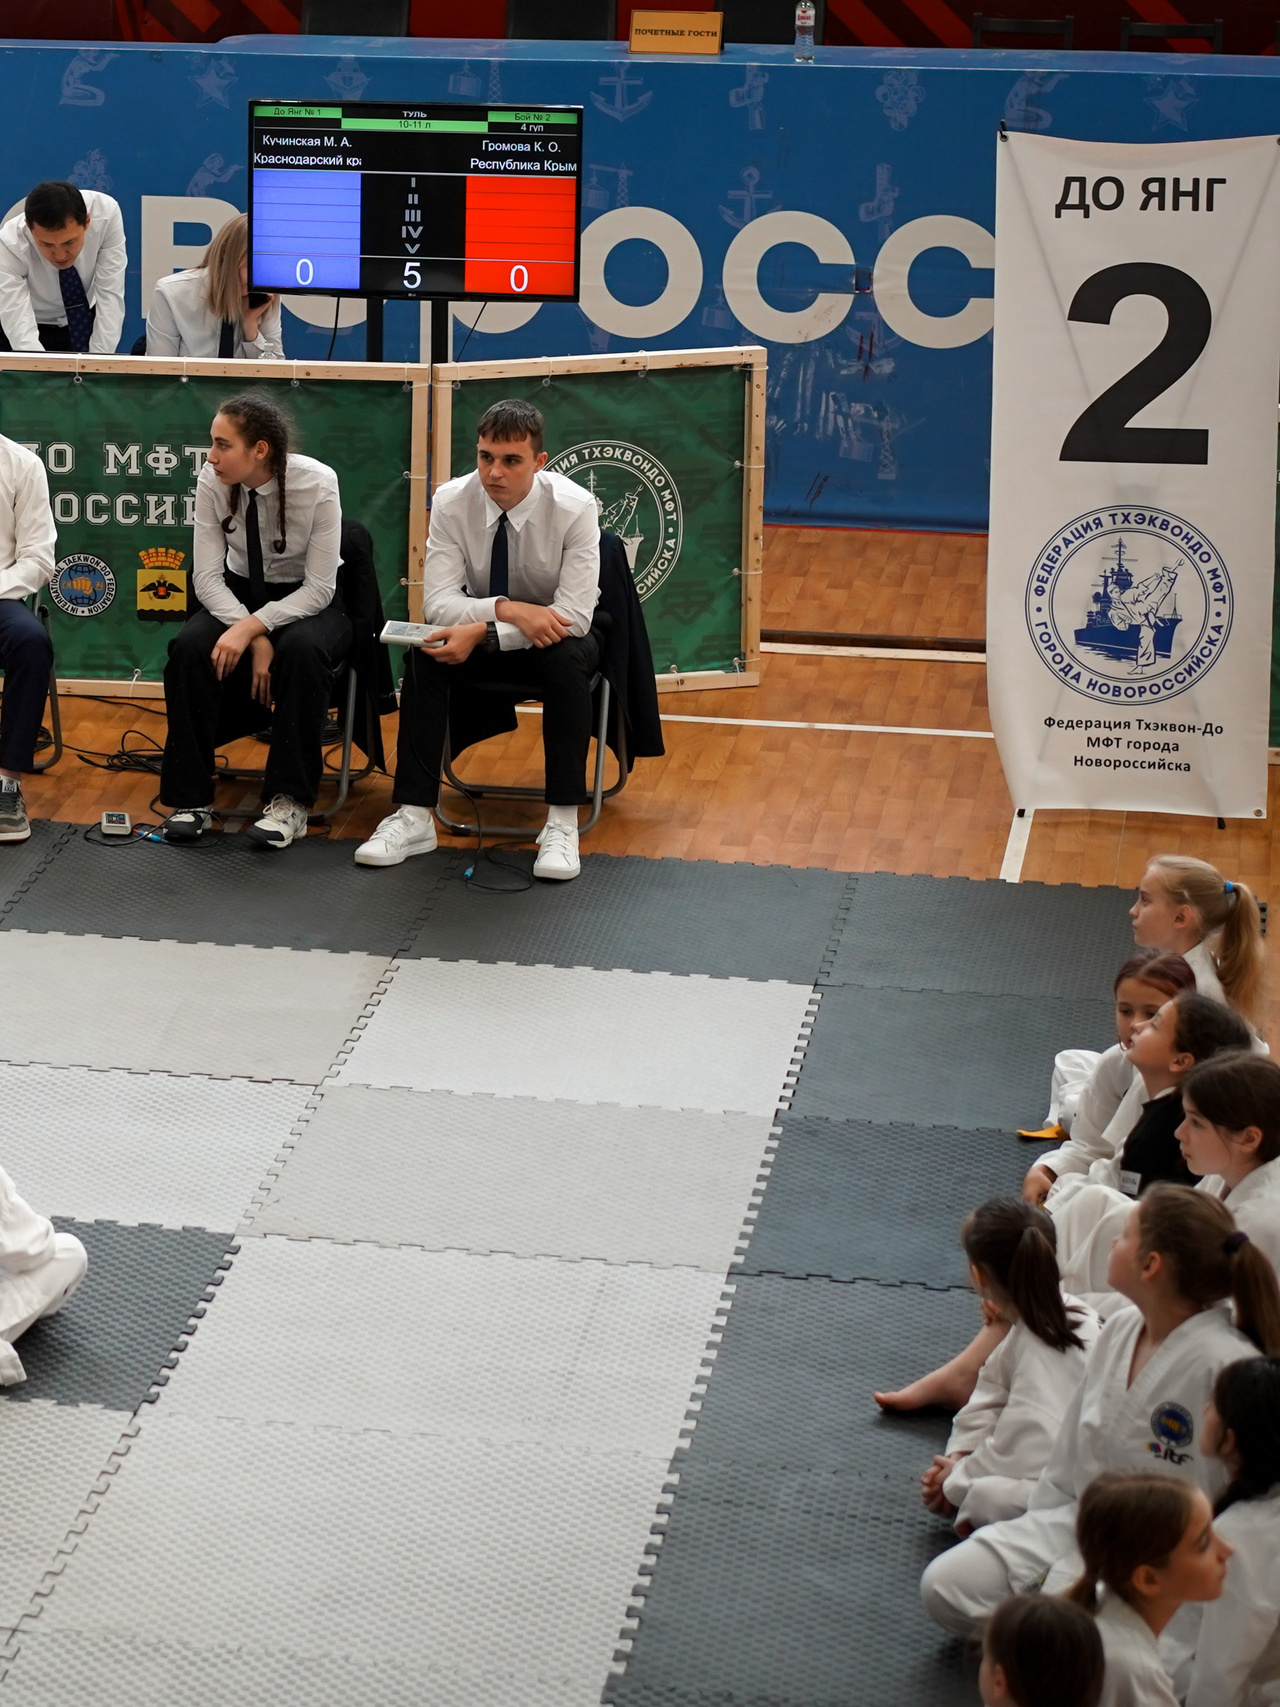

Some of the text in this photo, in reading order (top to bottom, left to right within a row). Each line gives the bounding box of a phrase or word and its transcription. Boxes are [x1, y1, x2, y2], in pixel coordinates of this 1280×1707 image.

[634, 28, 685, 37] ПОЧЕТНЫЕ
[273, 107, 285, 116] До
[287, 108, 303, 116] Янг
[514, 113, 531, 121] Бой
[399, 120, 422, 129] 10-11
[520, 123, 544, 133] 4 гуп
[262, 135, 353, 147] Кучинская М. А.
[482, 140, 562, 152] Громова К. О.
[253, 152, 343, 166] Краснодарский
[470, 158, 577, 172] Республика Крым
[1054, 175, 1227, 219] ДО ЯНГ
[405, 209, 421, 222] III
[401, 226, 424, 239] IV
[405, 243, 421, 254] V
[295, 258, 314, 286] 0
[403, 262, 422, 289] 5
[509, 264, 529, 292] 0
[1058, 261, 1212, 465] 2
[104, 443, 212, 477] МФТ
[582, 446, 666, 488] ТХЭКВОНДО
[660, 488, 677, 522] МФТ
[1034, 512, 1226, 605] ФЕДЕРАЦИЯ ТХЭКВОНДО МФТ
[51, 566, 79, 615] INTERNATIONAL
[87, 578, 115, 615] FEDERATION
[1034, 620, 1224, 699] ГОРОДА НОВОРОССИЙСКА
[1044, 716, 1224, 736] Федерация Тхэквон-До
[1086, 736, 1180, 753] МФТ города
[1073, 755, 1191, 773] Новороссийска
